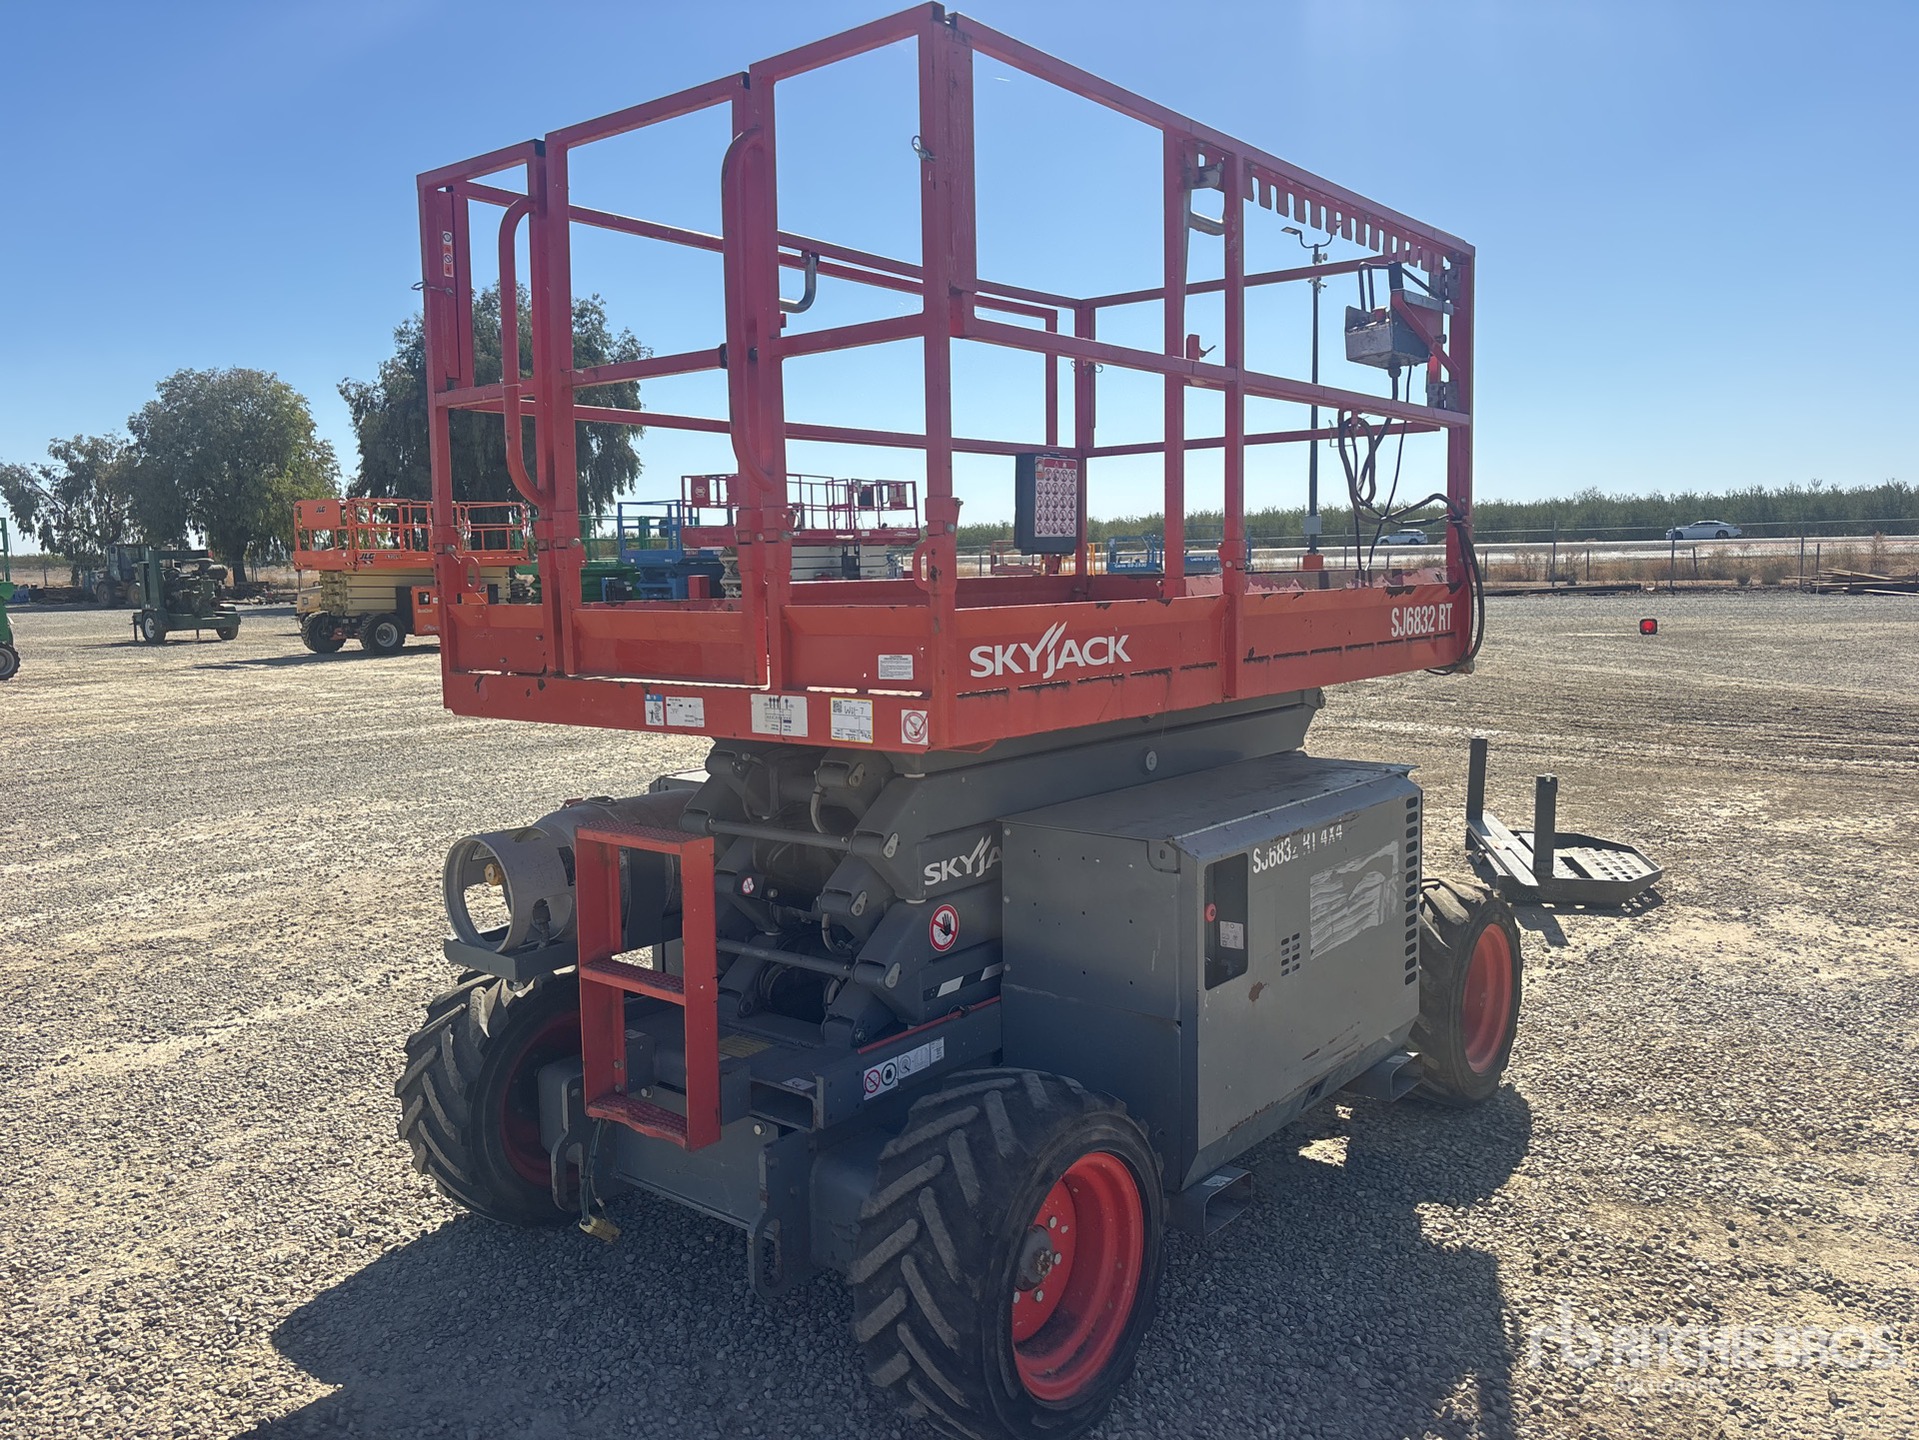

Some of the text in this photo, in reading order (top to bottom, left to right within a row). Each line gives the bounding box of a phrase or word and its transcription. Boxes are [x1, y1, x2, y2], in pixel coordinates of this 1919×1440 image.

[359, 552, 376, 560] JLG
[1391, 603, 1453, 637] SJ6832 RT
[969, 621, 1132, 679] SKYJACK
